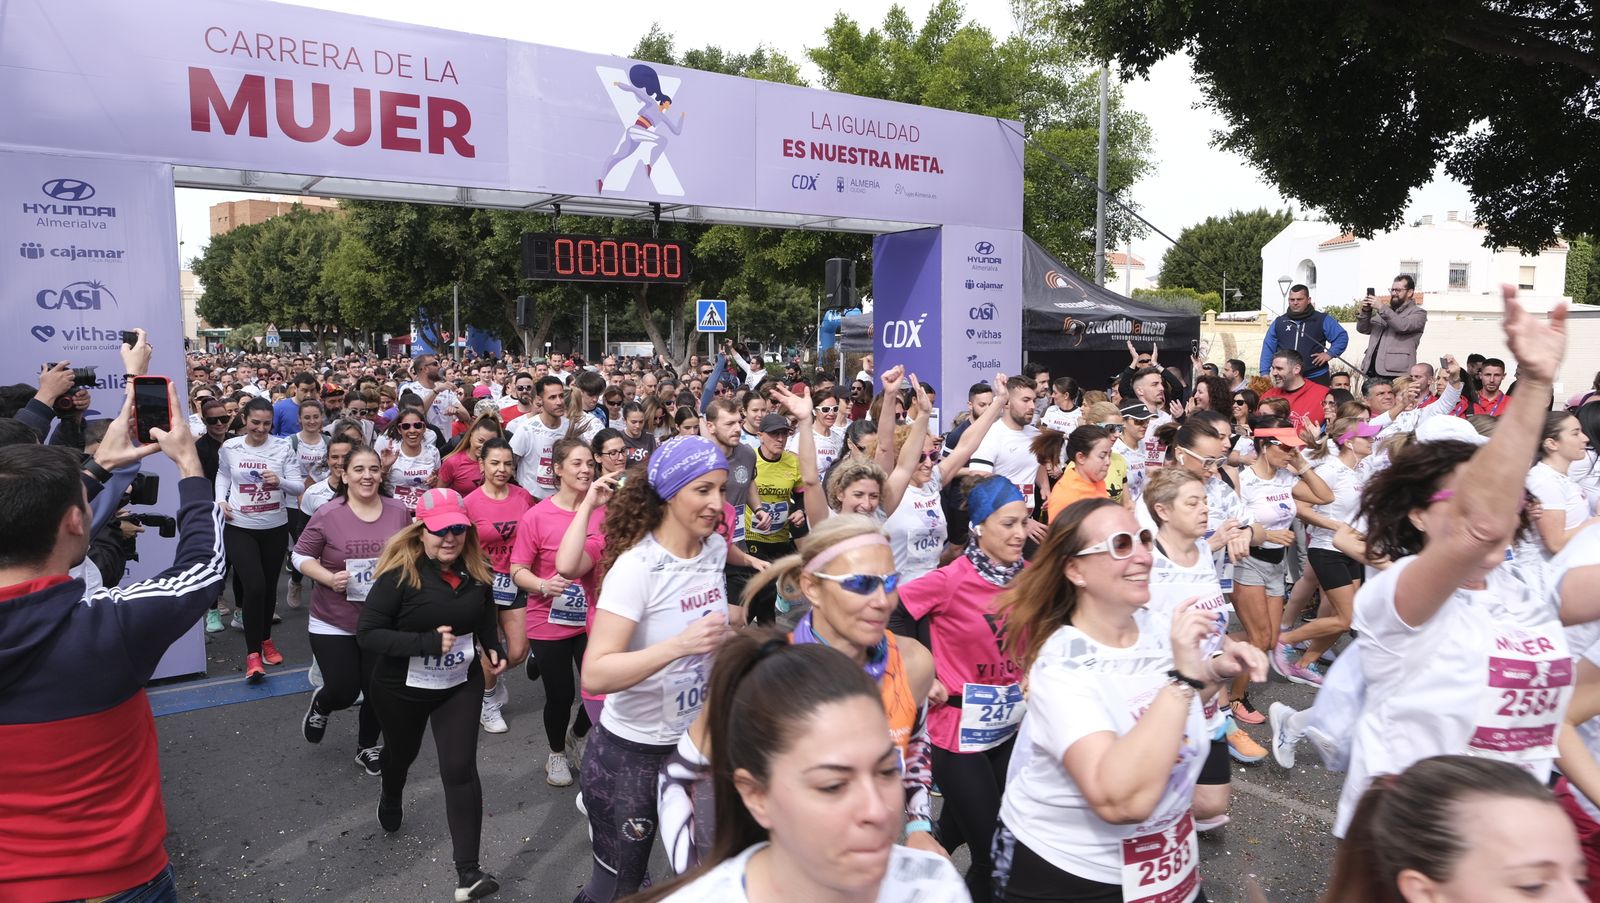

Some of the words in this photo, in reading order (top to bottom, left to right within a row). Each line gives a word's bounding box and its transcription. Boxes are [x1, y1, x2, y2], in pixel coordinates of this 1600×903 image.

[204, 26, 363, 73] CARRERA
[375, 50, 413, 79] DE
[424, 57, 459, 85] LA
[188, 66, 476, 159] MUJER
[812, 112, 832, 131] LA
[838, 115, 920, 142] IGUALDAD
[783, 139, 806, 158] ES
[811, 142, 891, 169] NUESTRA
[895, 153, 944, 174] META.
[792, 173, 820, 190] CDX
[23, 203, 116, 217] HYUNDAI
[36, 217, 107, 229] Almerialva
[50, 245, 125, 261] cajamar
[555, 238, 681, 279] 00:00:00
[967, 256, 1002, 264] HYUNDAI
[976, 281, 1004, 290] cajamar
[36, 287, 102, 310] CASI
[969, 306, 994, 320] CASI
[882, 313, 928, 348] CDX
[977, 330, 1002, 339] vithas
[972, 359, 1001, 371] aqualia
[249, 492, 271, 502] 723
[400, 494, 418, 505] 252
[1266, 493, 1290, 502] MUJER
[680, 588, 722, 612] MUJER
[979, 704, 1015, 722] 247
[1139, 840, 1191, 887] 2583
